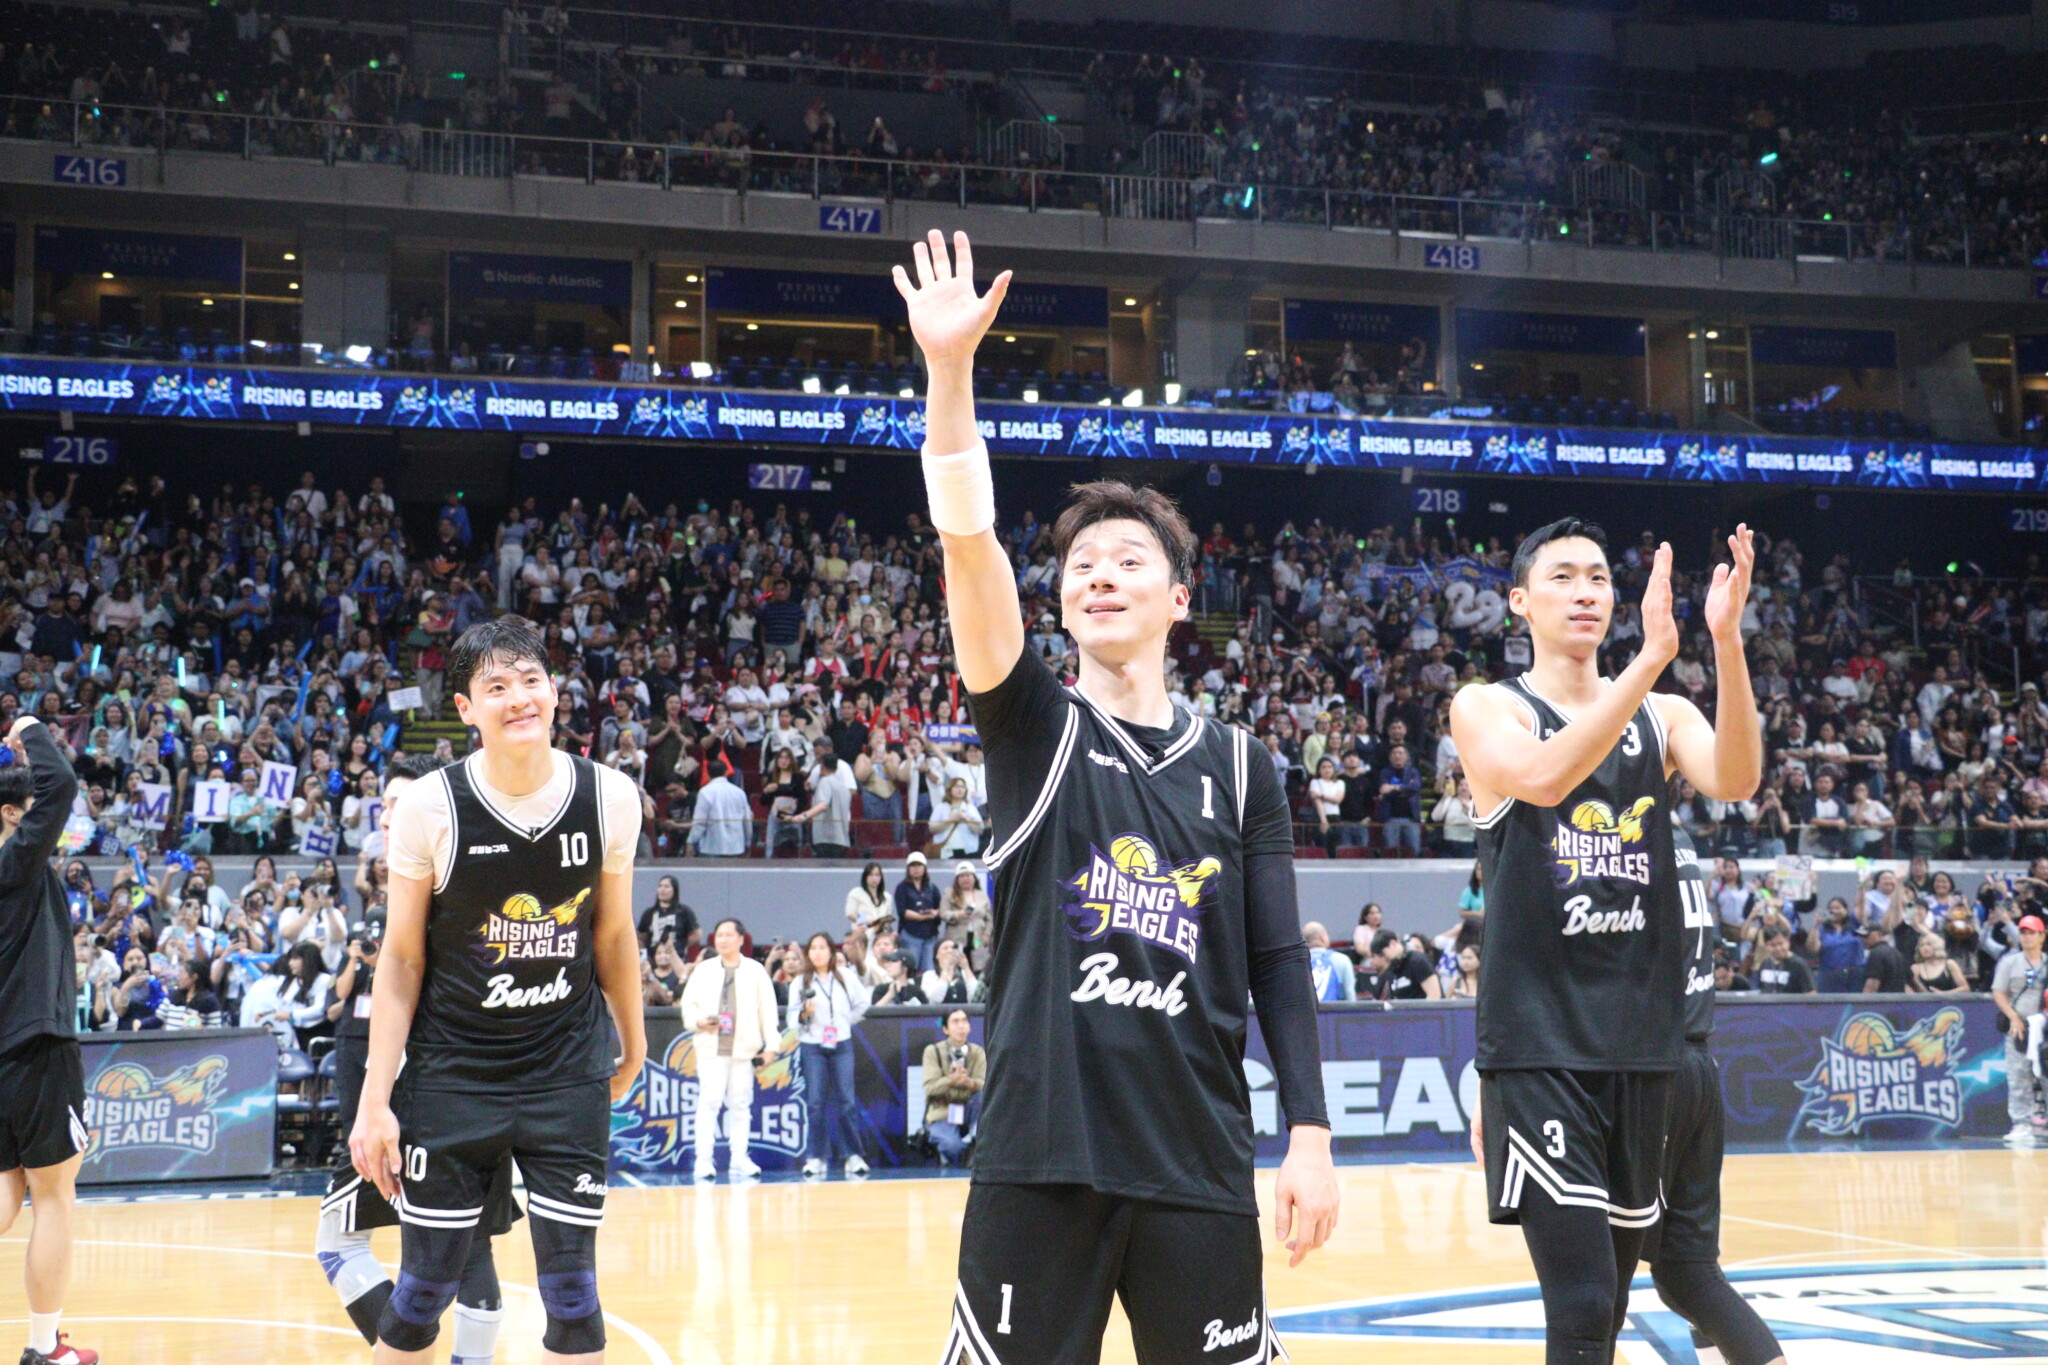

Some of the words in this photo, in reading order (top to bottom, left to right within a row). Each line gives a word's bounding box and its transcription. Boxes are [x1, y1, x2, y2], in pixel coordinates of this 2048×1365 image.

[62, 158, 119, 185] 416
[826, 207, 874, 232] 417
[1430, 245, 1474, 270] 418
[496, 271, 544, 285] Nordic
[548, 274, 603, 289] Atlantic
[0, 375, 52, 396] ISING
[57, 377, 134, 399] EAGLES
[243, 385, 306, 407] RISING
[310, 389, 383, 410] EAGLES
[486, 397, 546, 418] RISING
[550, 400, 619, 420] EAGLES
[718, 407, 776, 428] RISING
[779, 410, 846, 430] EAGLES
[999, 421, 1064, 440] EAGLES
[1154, 427, 1208, 447] RISING
[1211, 430, 1272, 450] EAGLES
[53, 436, 109, 464] 216
[1359, 436, 1411, 455] RISING
[1413, 438, 1473, 457] EAGLES
[1556, 445, 1606, 464] RISING
[1608, 447, 1666, 465] EAGLES
[1746, 452, 1795, 471] RISING
[1797, 454, 1853, 472] EAGLES
[1930, 459, 1979, 477] RISING
[1980, 460, 2035, 479] EAGLES
[757, 464, 804, 490] 217
[1417, 488, 1460, 513] 218
[2011, 508, 2048, 531] 219
[264, 769, 290, 801] N
[1201, 775, 1214, 819] 1
[206, 788, 218, 816] I
[559, 831, 588, 868] 10
[1088, 854, 1177, 912] RISING
[1580, 852, 1650, 886] EAGLES
[488, 913, 556, 942] RISING
[1561, 894, 1646, 936] Bench
[508, 930, 578, 959] EAGLES
[1111, 903, 1199, 965] EAGLES
[481, 966, 573, 1008] Bench
[1071, 952, 1188, 1017] Bench
[1829, 1050, 1917, 1092] RISING
[1858, 1079, 1958, 1120] EAGLES
[104, 1114, 211, 1148] EAGLES
[1543, 1119, 1565, 1158] 3
[405, 1144, 428, 1182] 10
[997, 1283, 1013, 1334] 1
[1203, 1307, 1259, 1352] Bench
